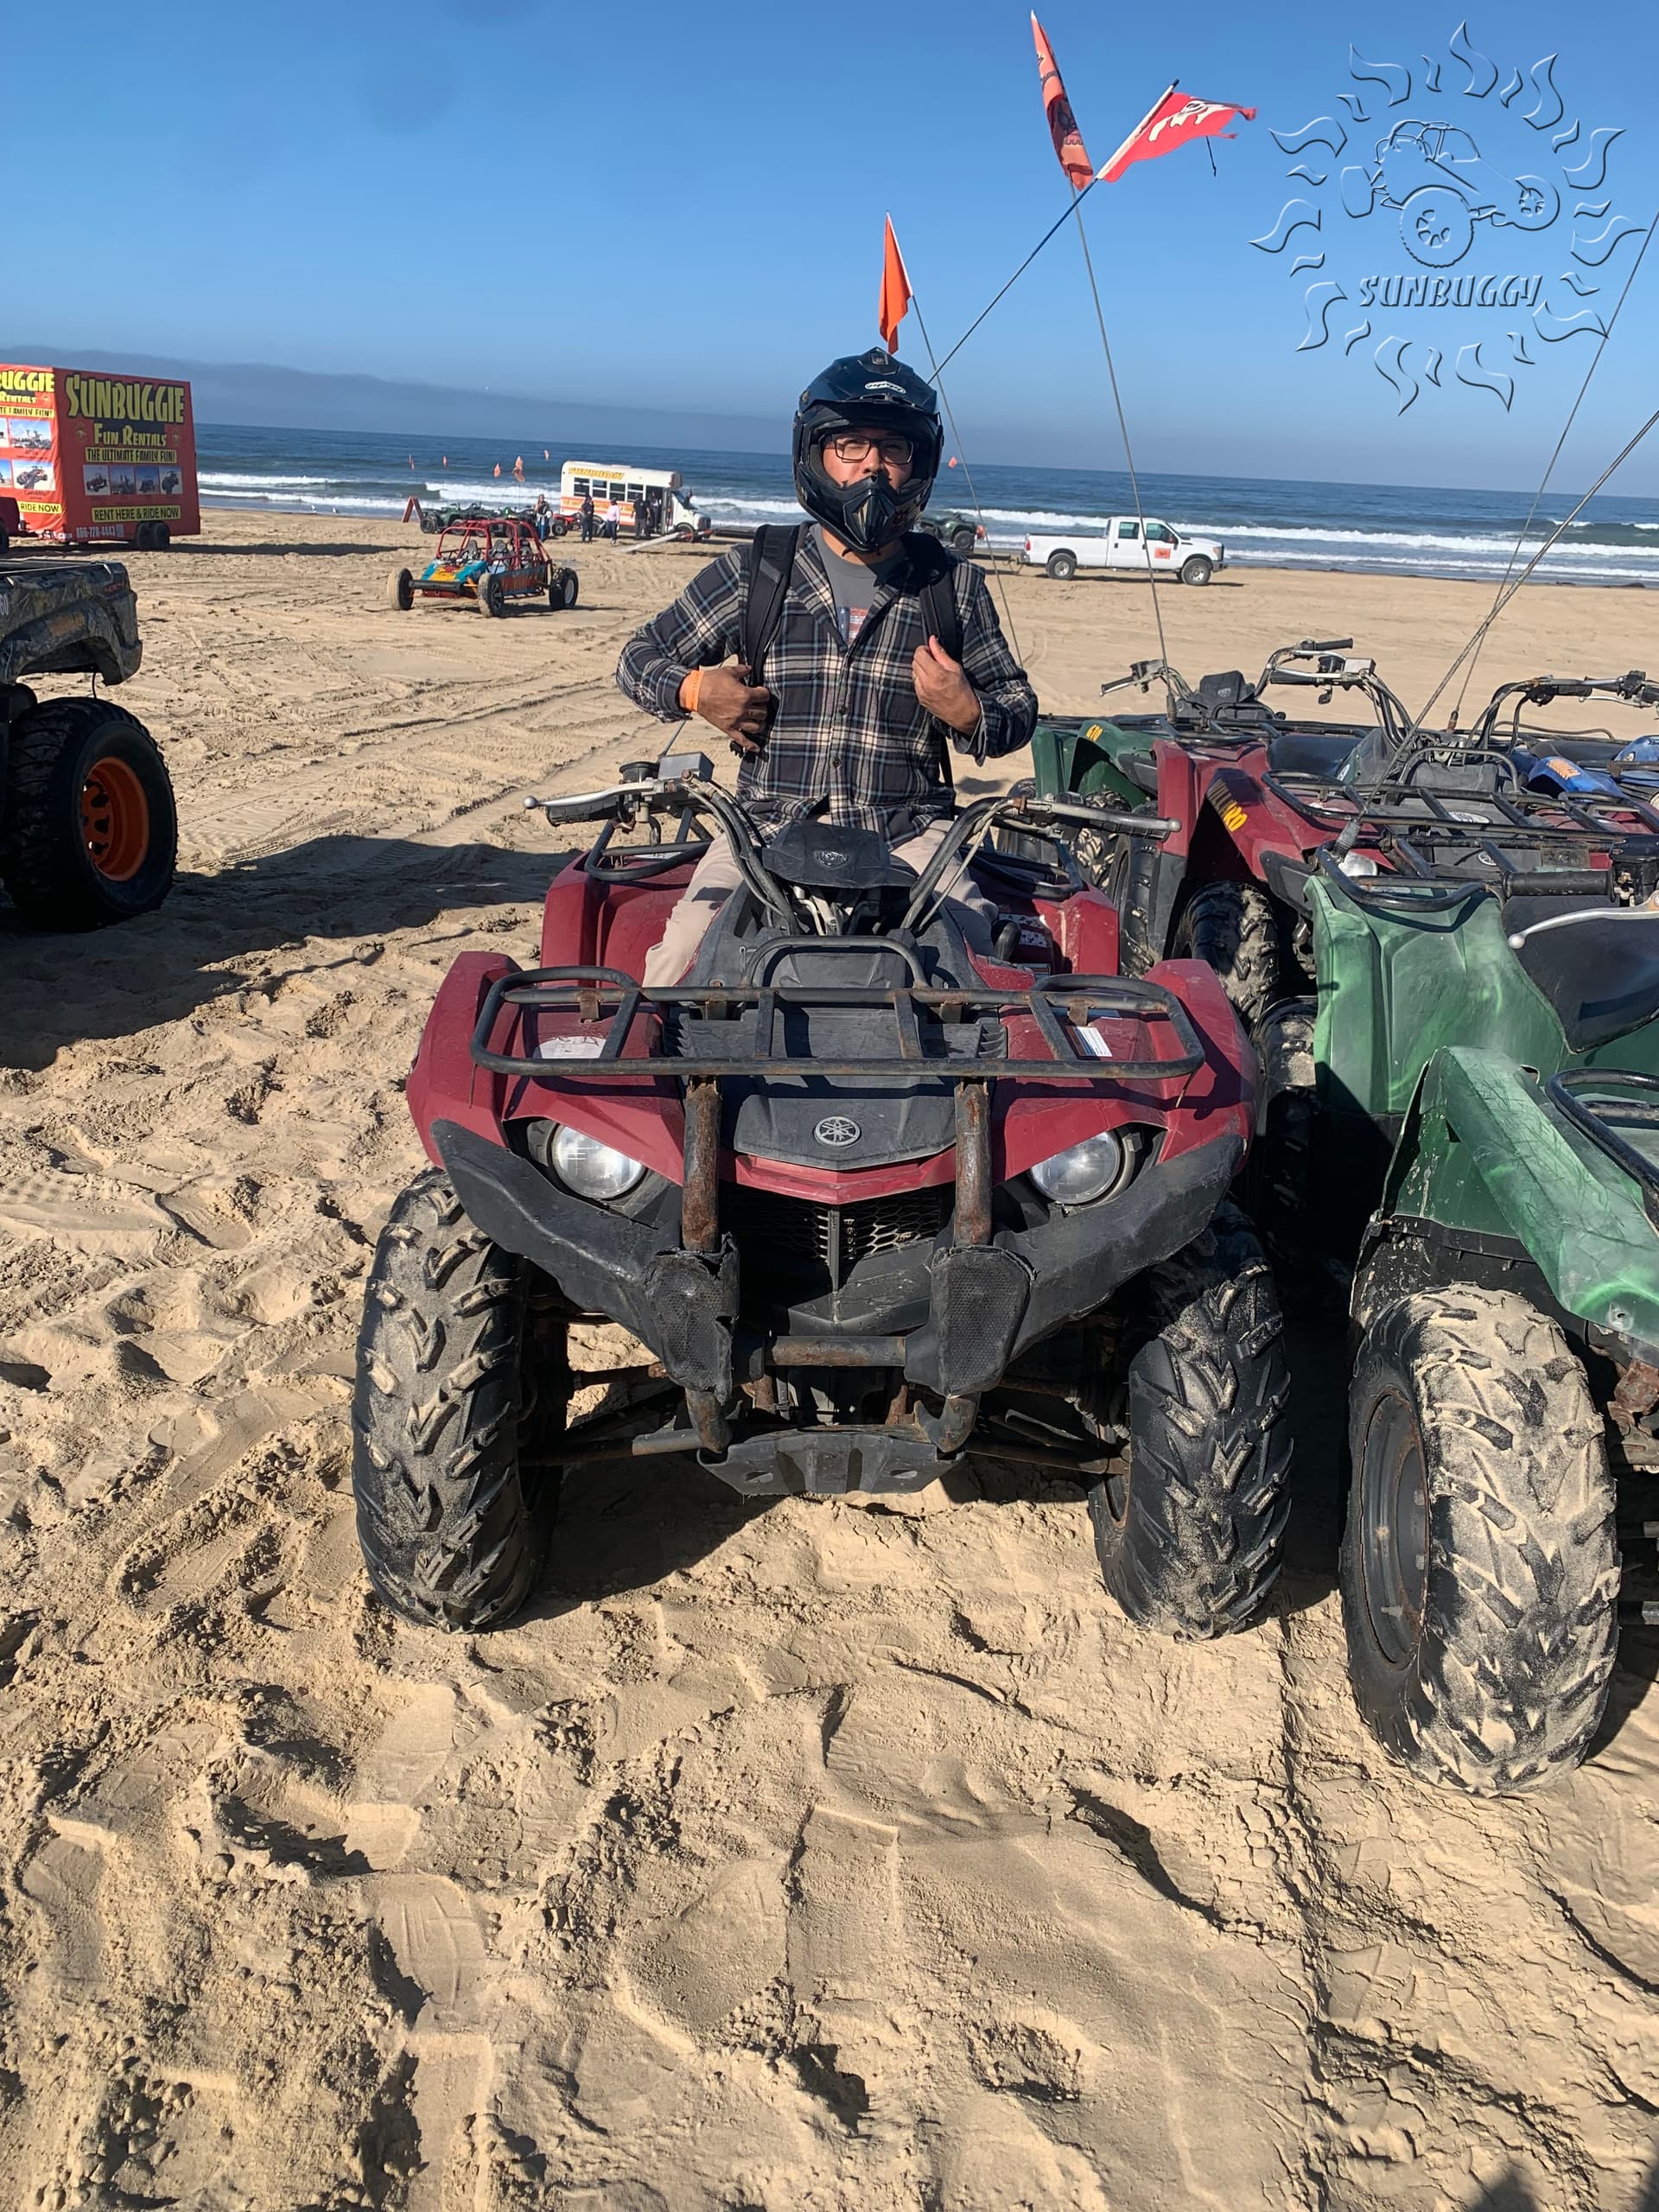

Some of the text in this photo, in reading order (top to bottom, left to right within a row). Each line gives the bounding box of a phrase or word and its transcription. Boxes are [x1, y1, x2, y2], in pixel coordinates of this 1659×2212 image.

[0, 370, 54, 392] UGGIE
[66, 373, 185, 423] SUNBUGGIE
[93, 423, 167, 447] FUN RENTALS
[86, 448, 100, 461] THE
[102, 448, 135, 462] ULTIMATE
[136, 450, 159, 462] FAMILY
[20, 503, 37, 512] RIDE
[94, 506, 179, 521] RENT HERE & RIDE NOW
